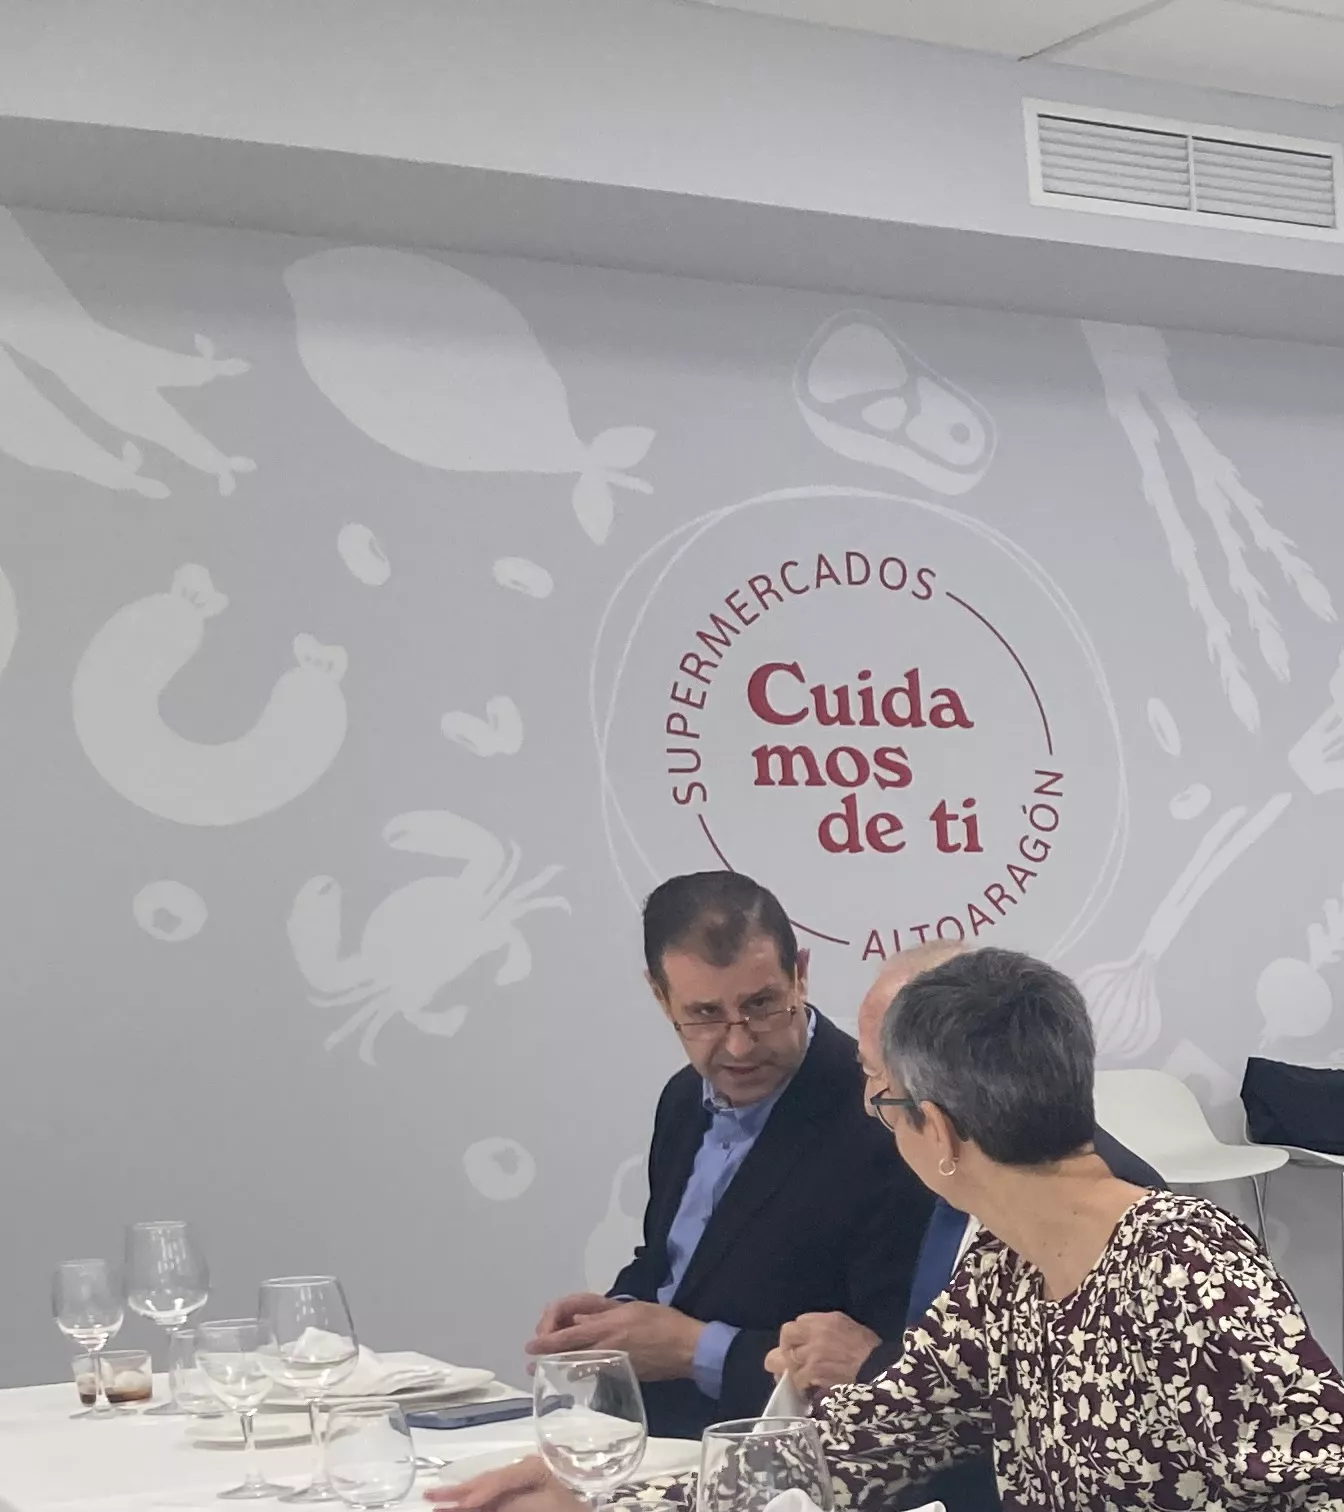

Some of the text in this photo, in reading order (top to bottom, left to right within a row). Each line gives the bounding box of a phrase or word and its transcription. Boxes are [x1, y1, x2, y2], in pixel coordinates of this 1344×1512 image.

[665, 550, 937, 806] SUPERMERCADOS
[746, 661, 975, 730] Cuida
[751, 743, 914, 790] mos
[816, 791, 985, 854] de ti
